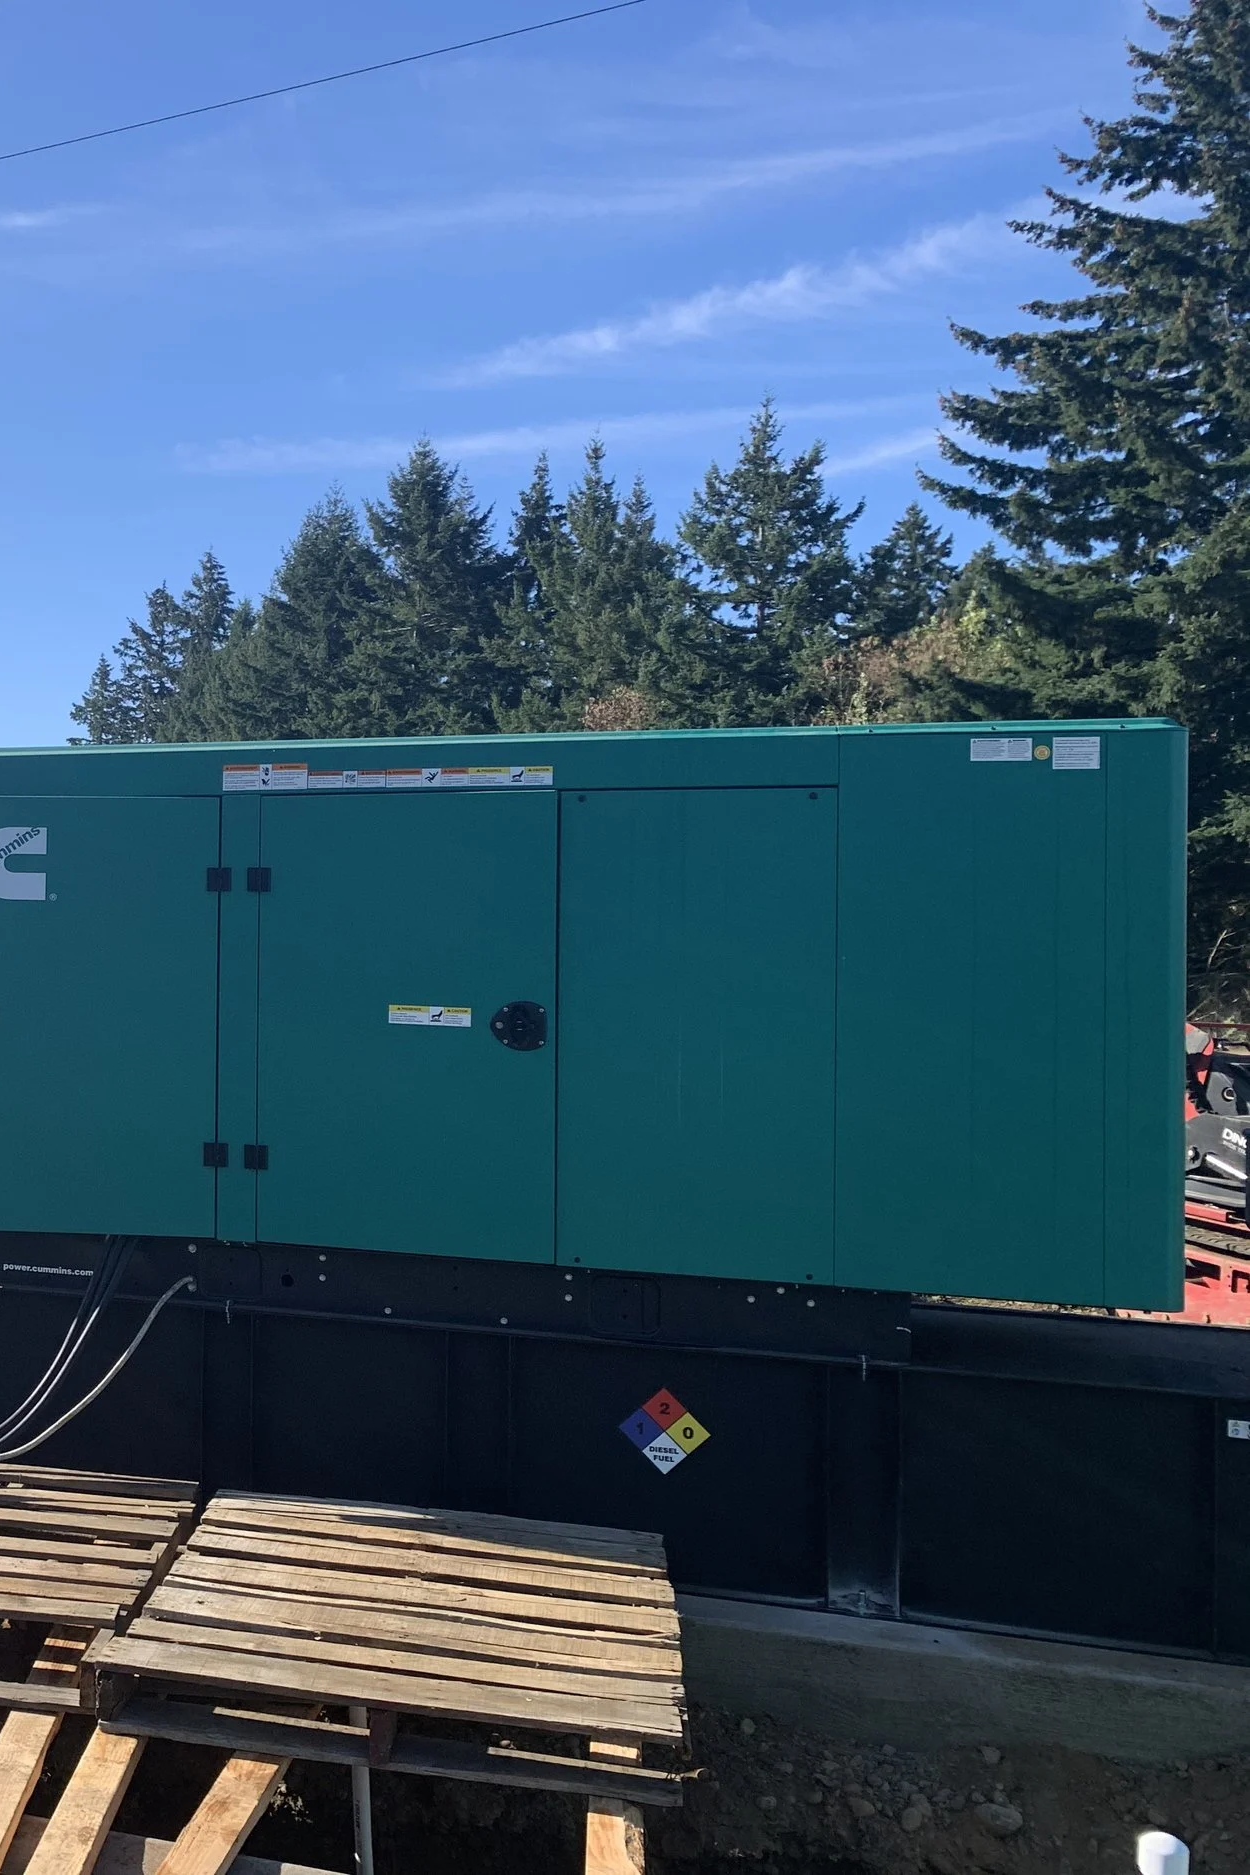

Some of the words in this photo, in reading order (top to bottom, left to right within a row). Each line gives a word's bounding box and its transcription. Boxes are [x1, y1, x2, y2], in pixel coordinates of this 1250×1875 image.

[2, 1263, 94, 1277] power.cummins.com
[659, 1402, 671, 1415] 2
[635, 1422, 644, 1435] 1
[682, 1426, 694, 1440] 0
[649, 1445, 680, 1455] DIESEL
[653, 1454, 675, 1463] FUEL
